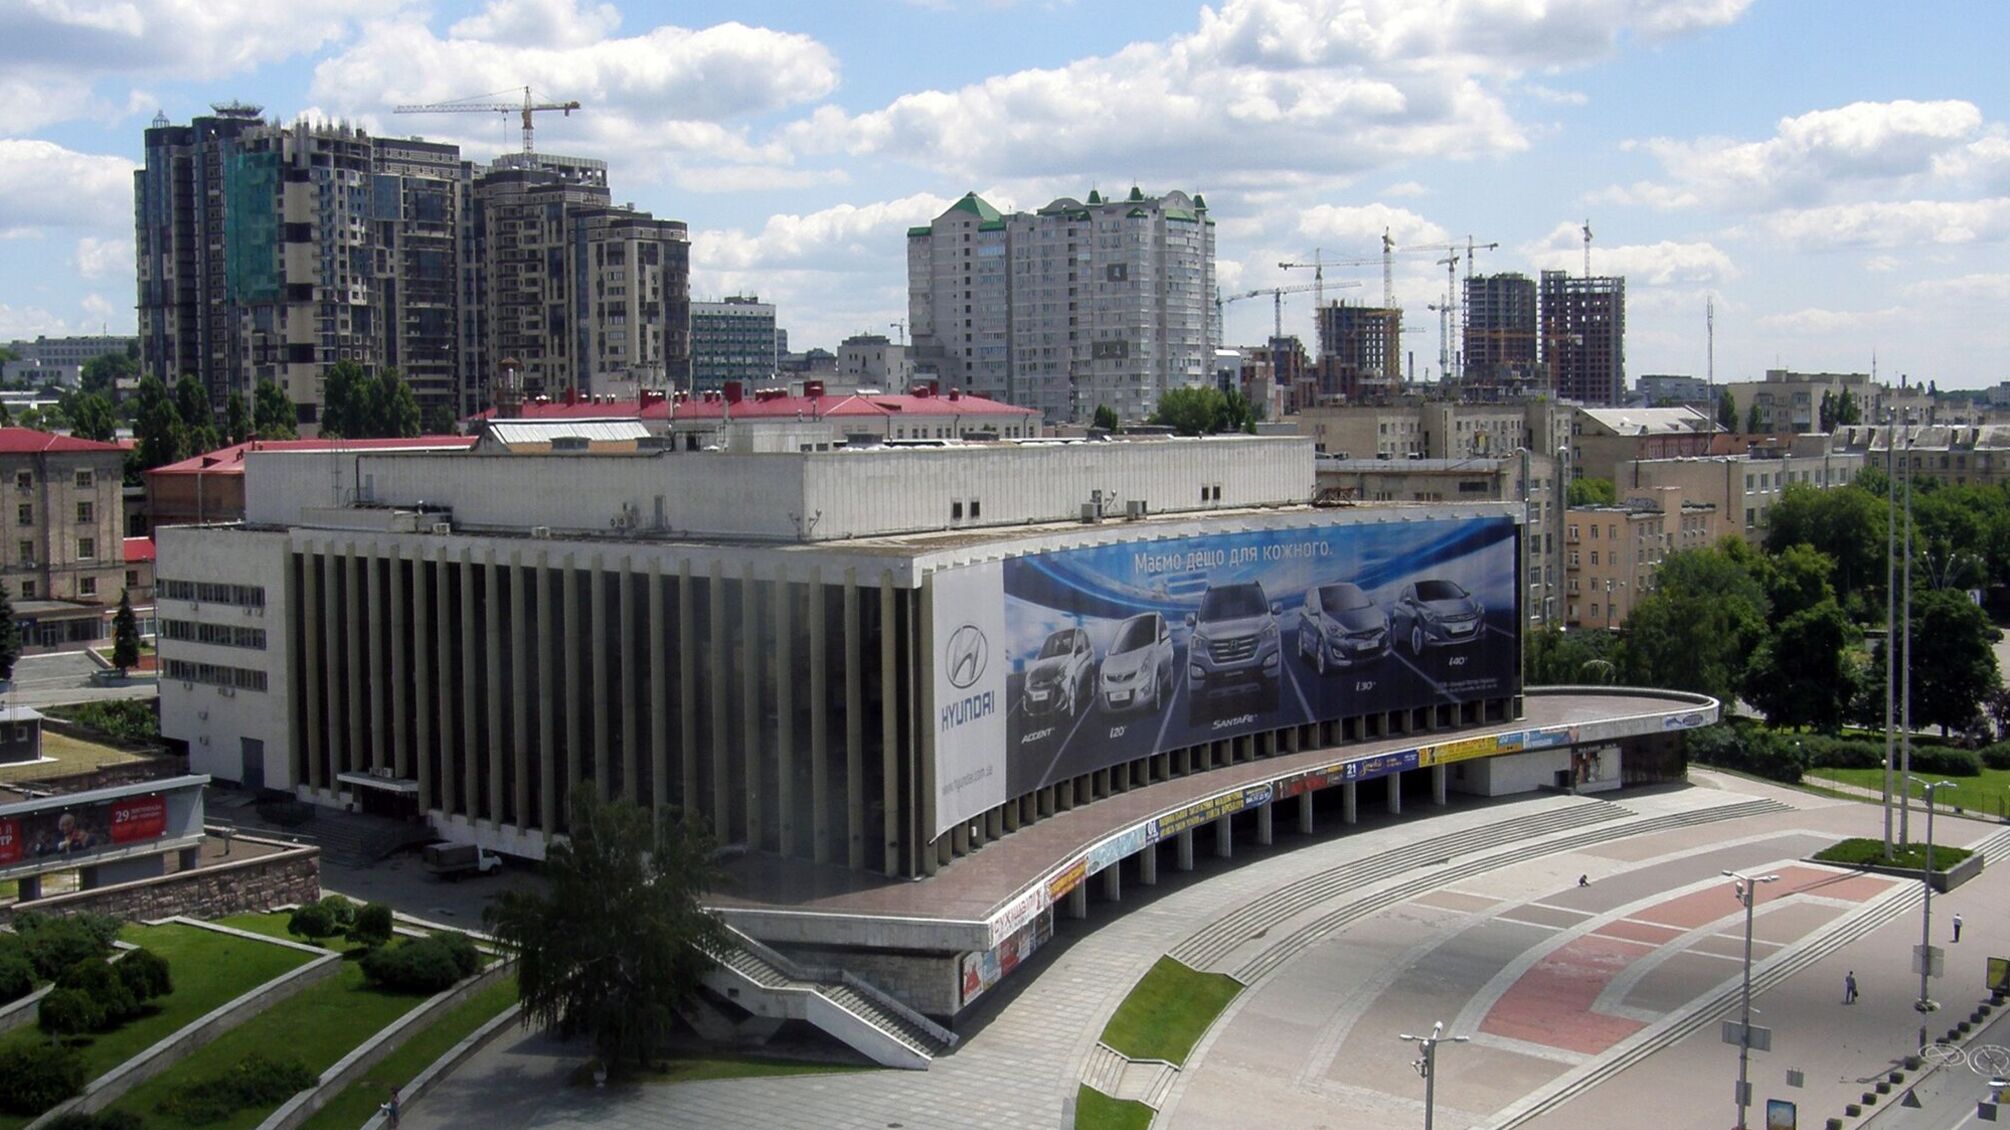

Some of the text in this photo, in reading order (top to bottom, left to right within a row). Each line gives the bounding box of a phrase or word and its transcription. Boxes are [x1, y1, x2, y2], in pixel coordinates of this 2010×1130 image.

[1135, 540, 1334, 575] Маємо дещо для кожного.
[941, 691, 995, 732] HYUNDAI
[115, 810, 129, 823] 29
